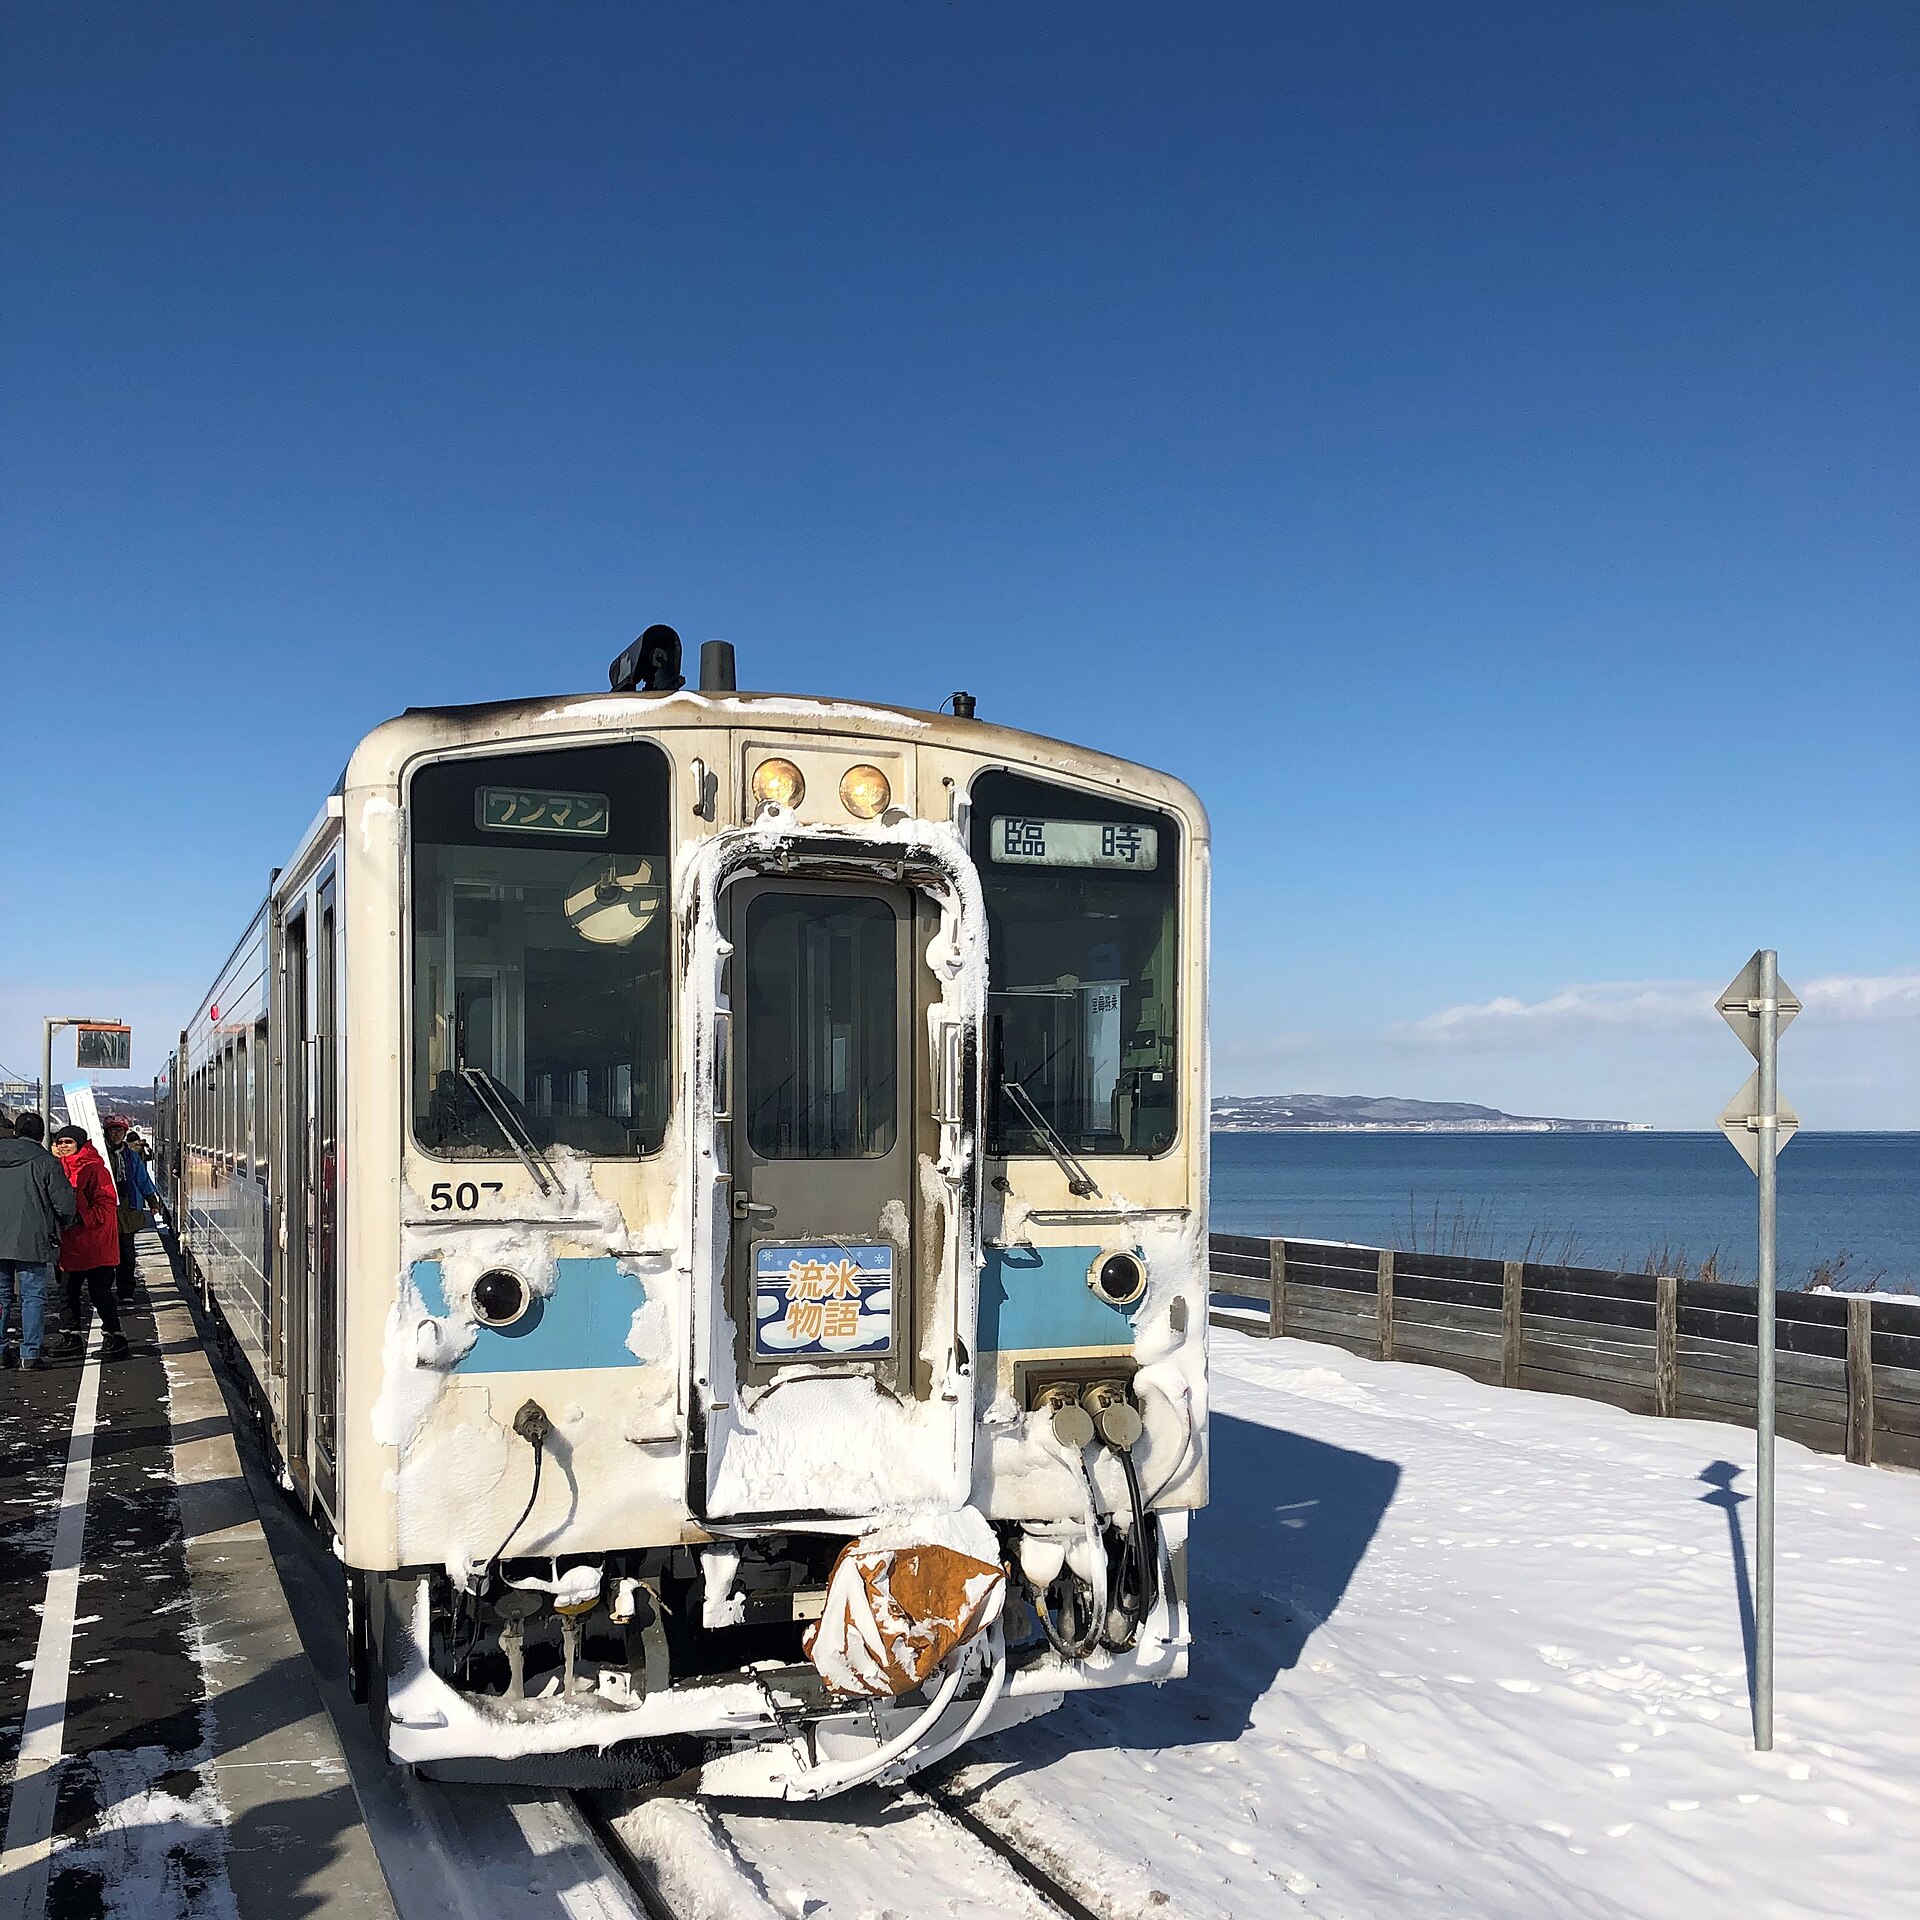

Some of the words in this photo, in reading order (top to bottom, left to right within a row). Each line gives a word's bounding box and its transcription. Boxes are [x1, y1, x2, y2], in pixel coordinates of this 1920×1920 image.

[489, 793, 604, 828] ワンマン
[1004, 818, 1142, 863] 臨時
[431, 1182, 504, 1212] 507
[787, 1260, 861, 1298] 流氷
[786, 1301, 860, 1339] 物語
